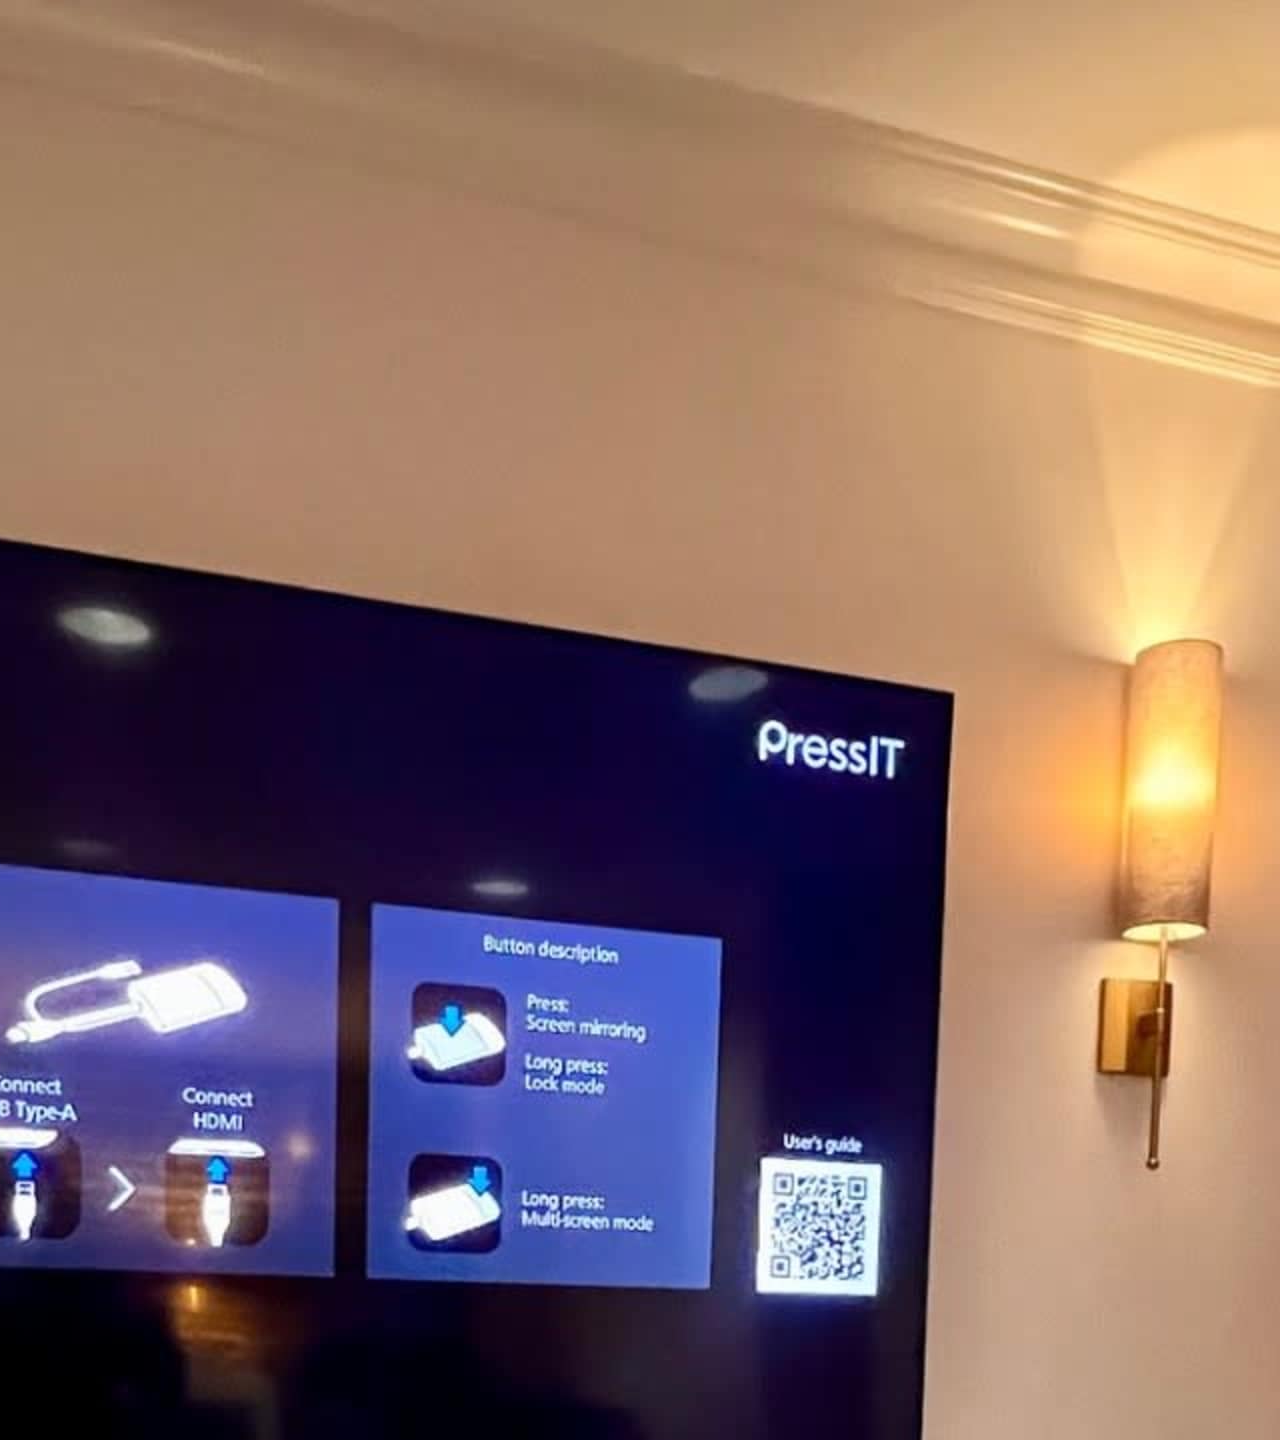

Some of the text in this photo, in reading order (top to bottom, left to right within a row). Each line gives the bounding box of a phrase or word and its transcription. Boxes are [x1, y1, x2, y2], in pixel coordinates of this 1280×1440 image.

[757, 718, 905, 780] PressIT
[483, 934, 619, 965] Button description
[526, 994, 569, 1014] Press:
[526, 1015, 647, 1044] Screen mirroring
[524, 1054, 609, 1079] Long press:
[524, 1076, 606, 1095] Lock mode
[182, 1086, 254, 1109] Connect
[16, 1100, 78, 1123] Type-A
[193, 1111, 243, 1131] HDMI
[783, 1132, 863, 1155] User's guide
[521, 1190, 606, 1212] Long press:
[521, 1211, 654, 1232] Multi-screen mode
